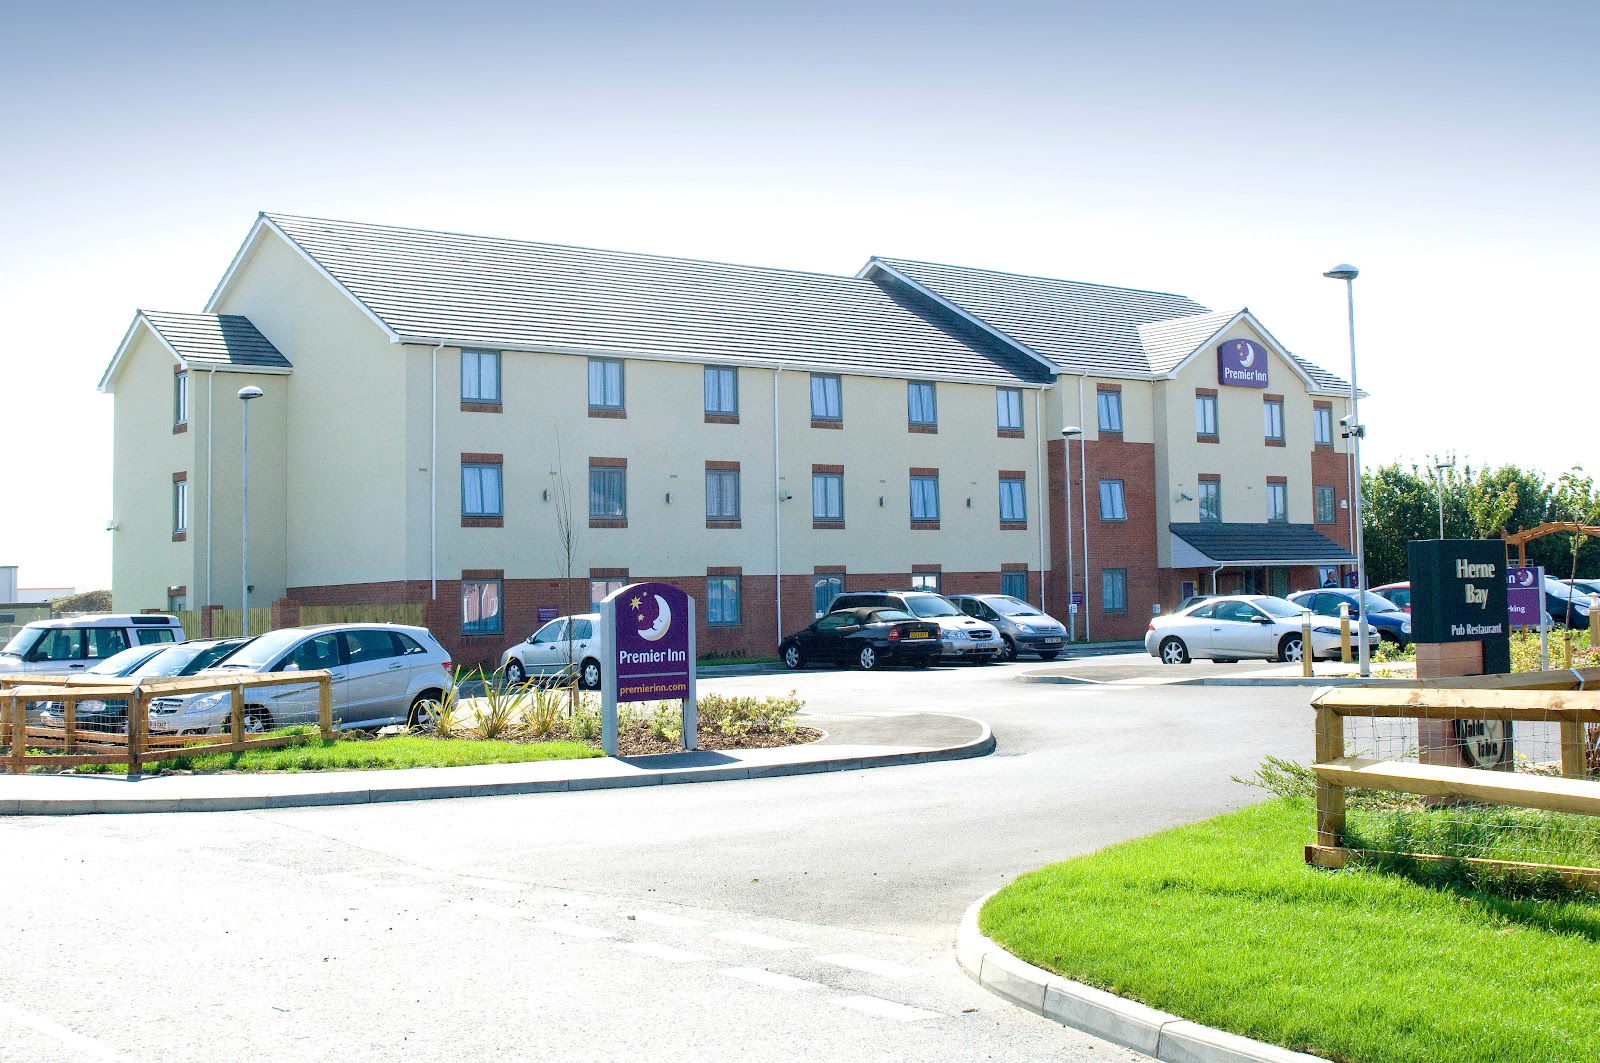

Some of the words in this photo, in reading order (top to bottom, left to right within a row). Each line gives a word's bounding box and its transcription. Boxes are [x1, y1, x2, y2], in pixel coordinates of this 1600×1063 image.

[1225, 368, 1254, 380] Premier
[1255, 370, 1267, 381] Inn
[1456, 559, 1495, 578] Herne
[1465, 584, 1488, 610] Bay
[1451, 624, 1465, 636] Pub
[1466, 623, 1502, 635] Restaurant
[620, 649, 666, 664] Premier
[668, 649, 685, 662] Inn
[620, 683, 686, 697] premierinn.com
[1476, 739, 1498, 758] Table
